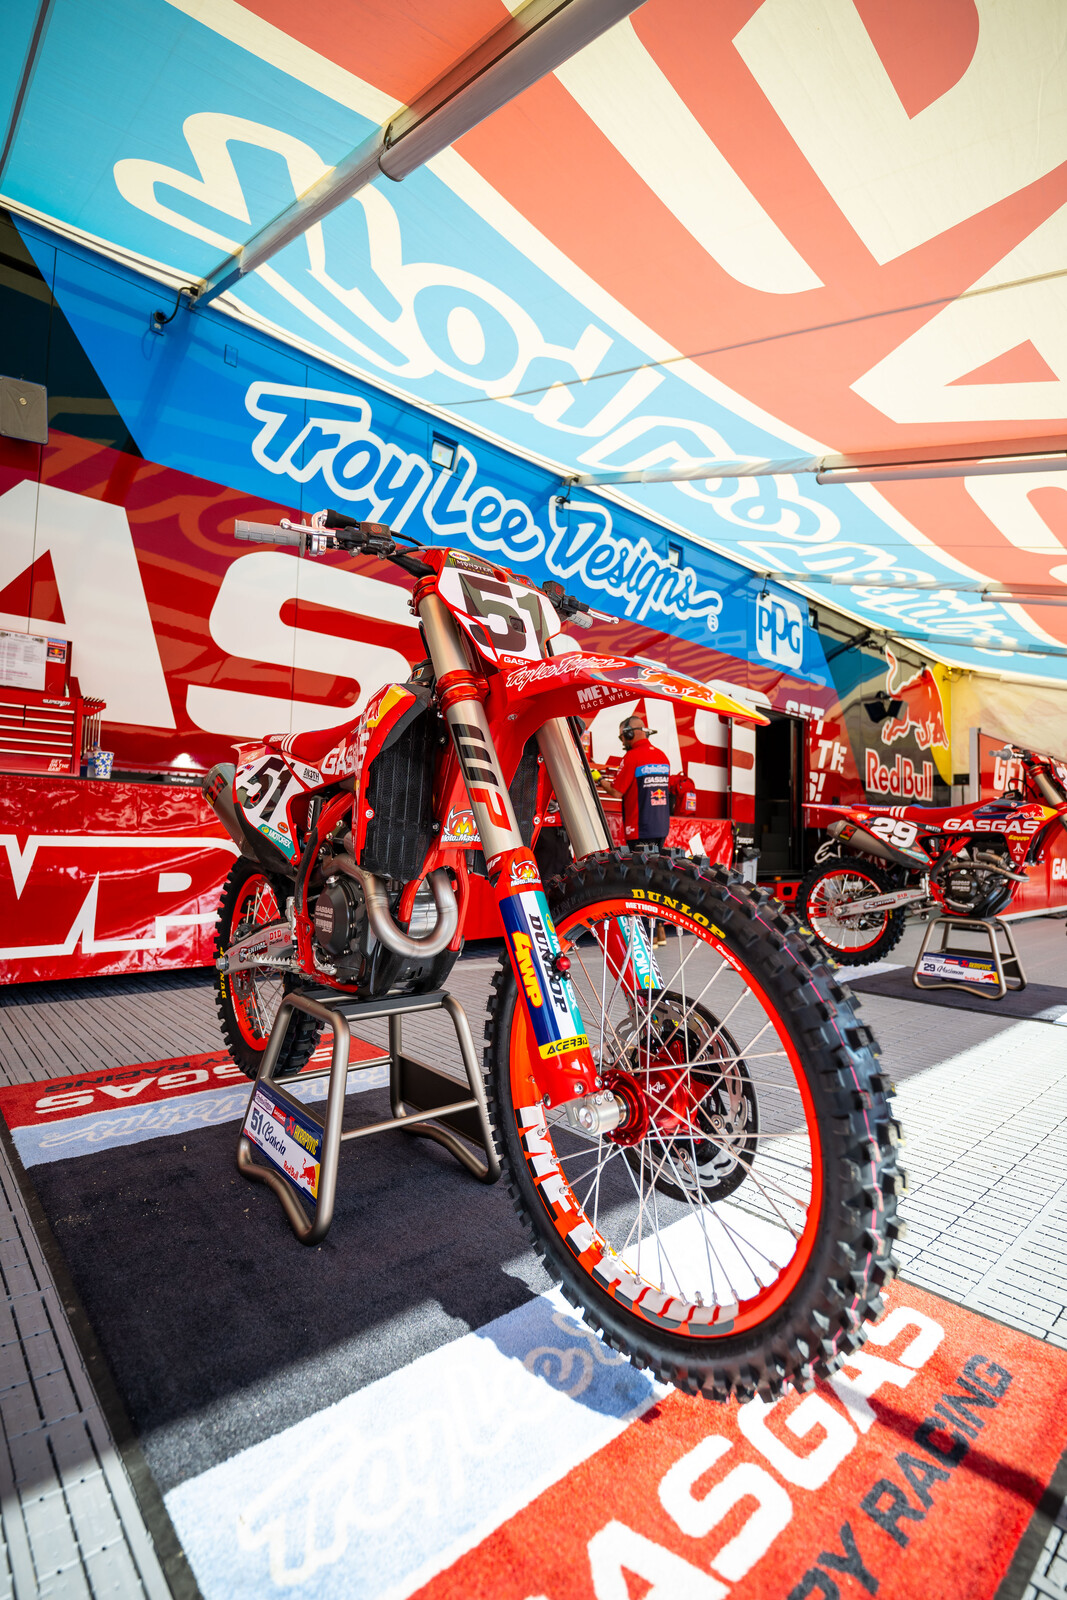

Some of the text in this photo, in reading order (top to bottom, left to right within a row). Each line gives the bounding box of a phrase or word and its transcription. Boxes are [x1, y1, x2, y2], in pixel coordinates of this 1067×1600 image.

[245, 381, 722, 621] Troy Lee Designs
[457, 560, 493, 574] MONSTER
[458, 572, 556, 660] 51
[580, 701, 605, 711] RACE
[236, 756, 297, 823] 51
[269, 828, 292, 848] MOTOREX
[871, 816, 918, 848] 29
[943, 818, 1041, 834] GASGAS
[625, 901, 659, 914] METHOD
[660, 908, 677, 921] RACE
[679, 917, 707, 939] WHEELS
[631, 888, 727, 940] DUNLOP
[923, 963, 936, 973] 29
[250, 1107, 263, 1136] 51
[860, 1354, 1012, 1548] RACING
